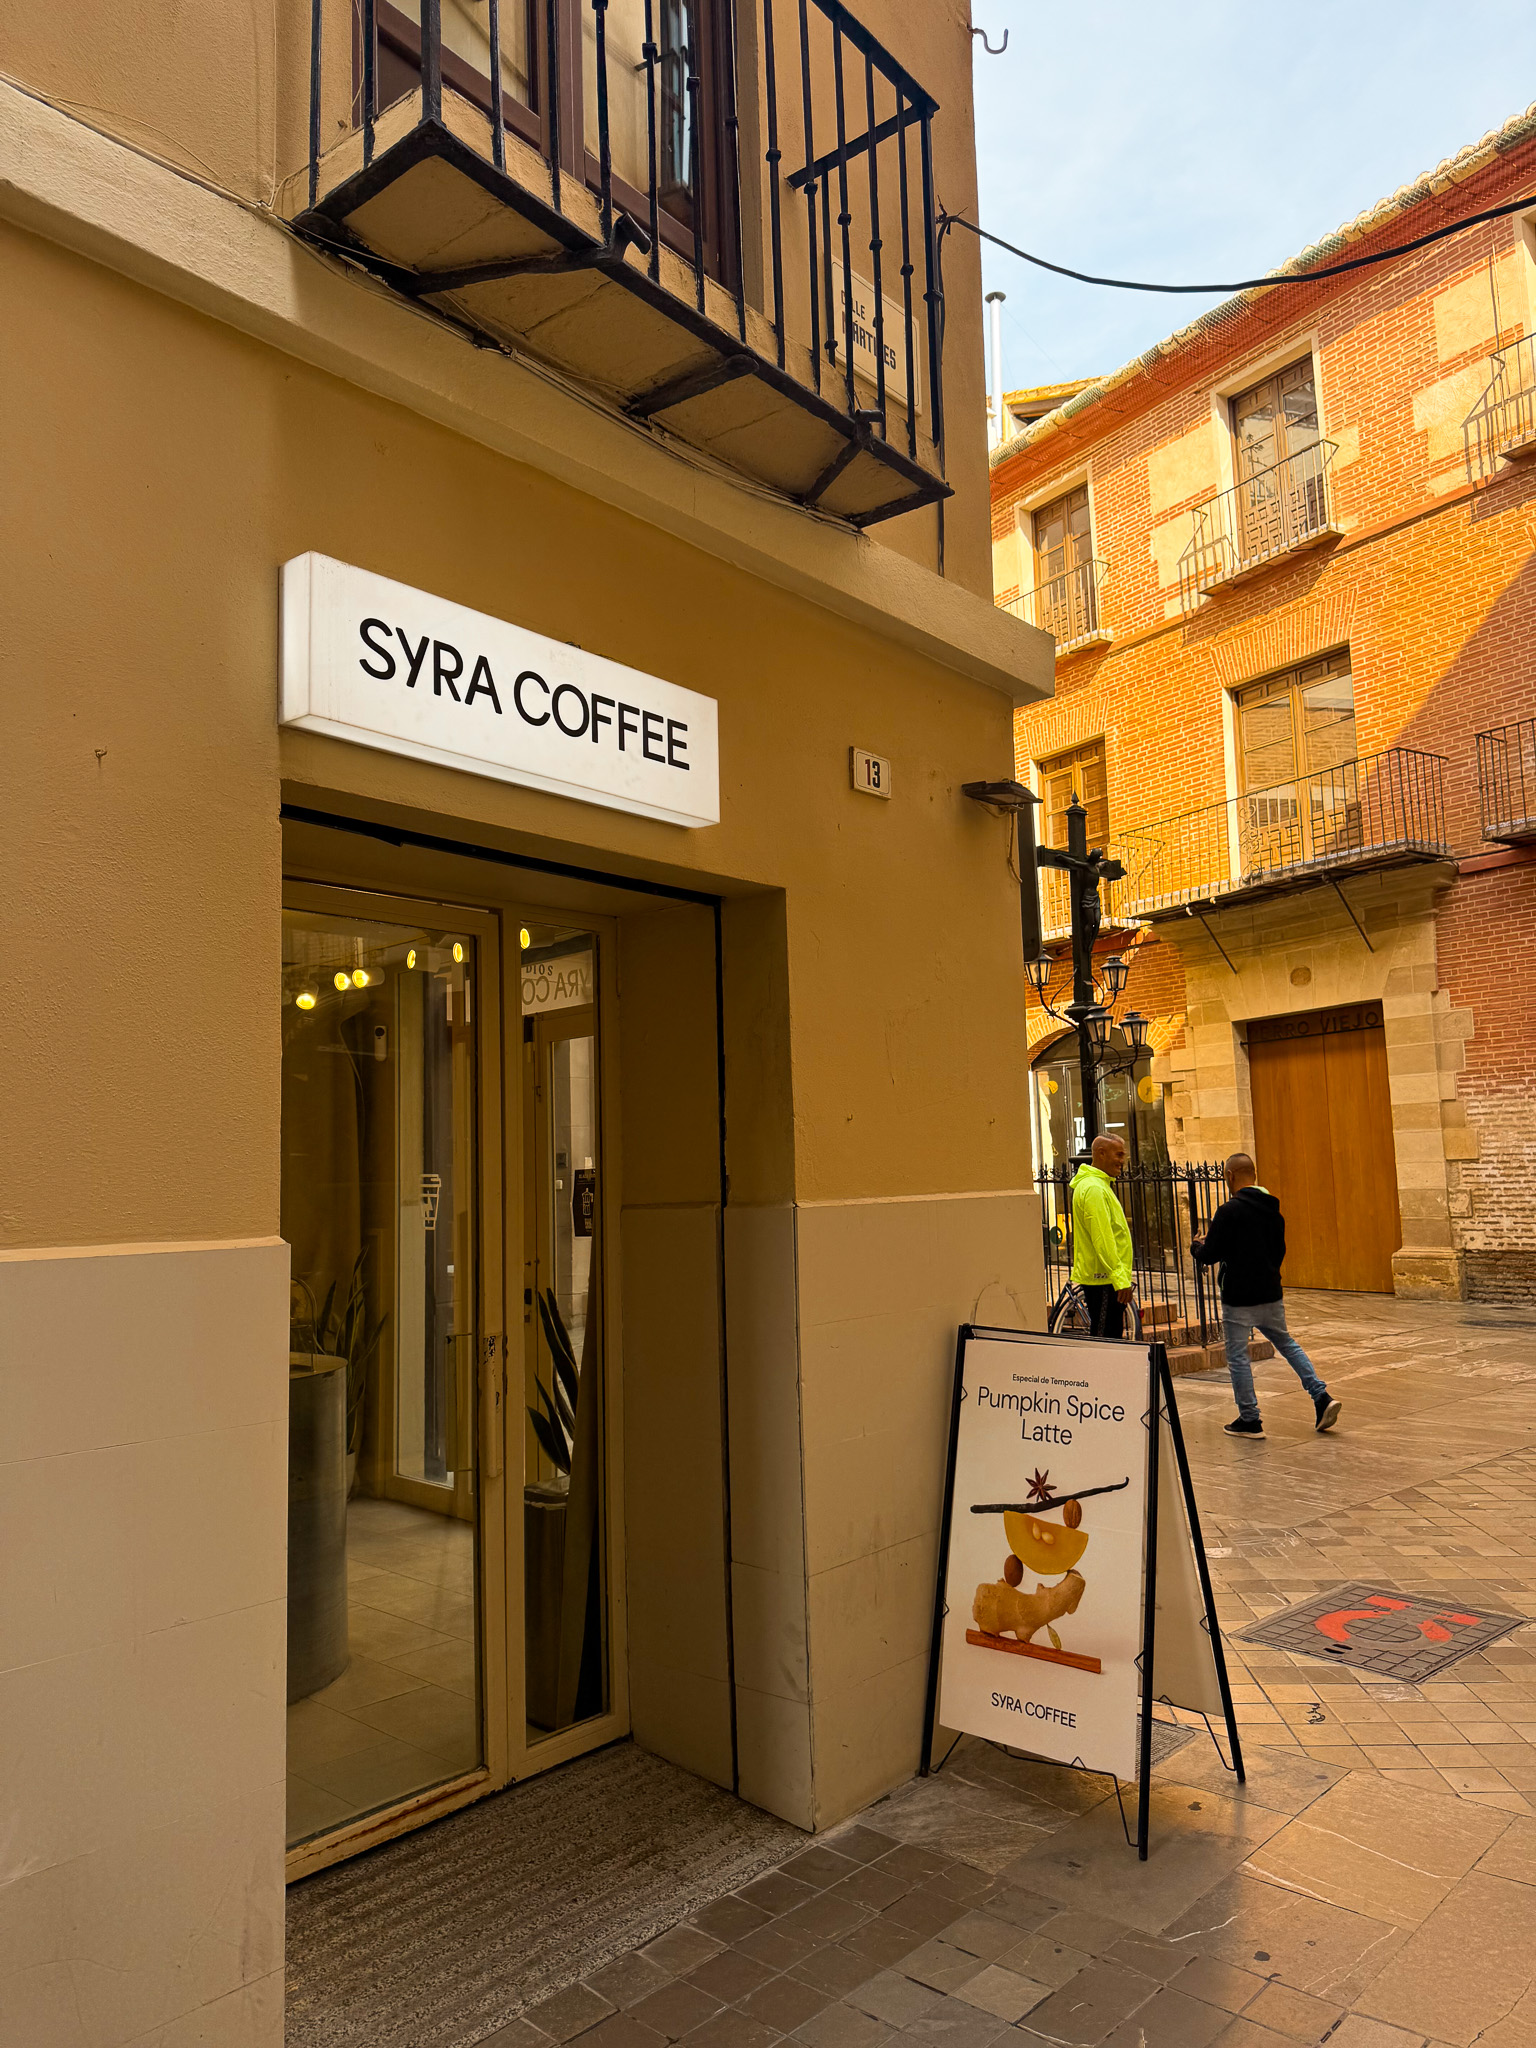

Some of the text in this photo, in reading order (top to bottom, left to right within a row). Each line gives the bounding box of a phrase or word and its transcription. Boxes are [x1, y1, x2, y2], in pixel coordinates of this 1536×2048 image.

[359, 618, 690, 771] SYRA COFFEE
[865, 758, 881, 789] 13
[1320, 1011, 1379, 1033] VIEJO
[1012, 1373, 1089, 1388] Especial de Temporada
[977, 1386, 1125, 1423] Pumpkin Spice
[1021, 1418, 1073, 1445] Latte
[991, 1692, 1076, 1728] SYRA COFFEE
